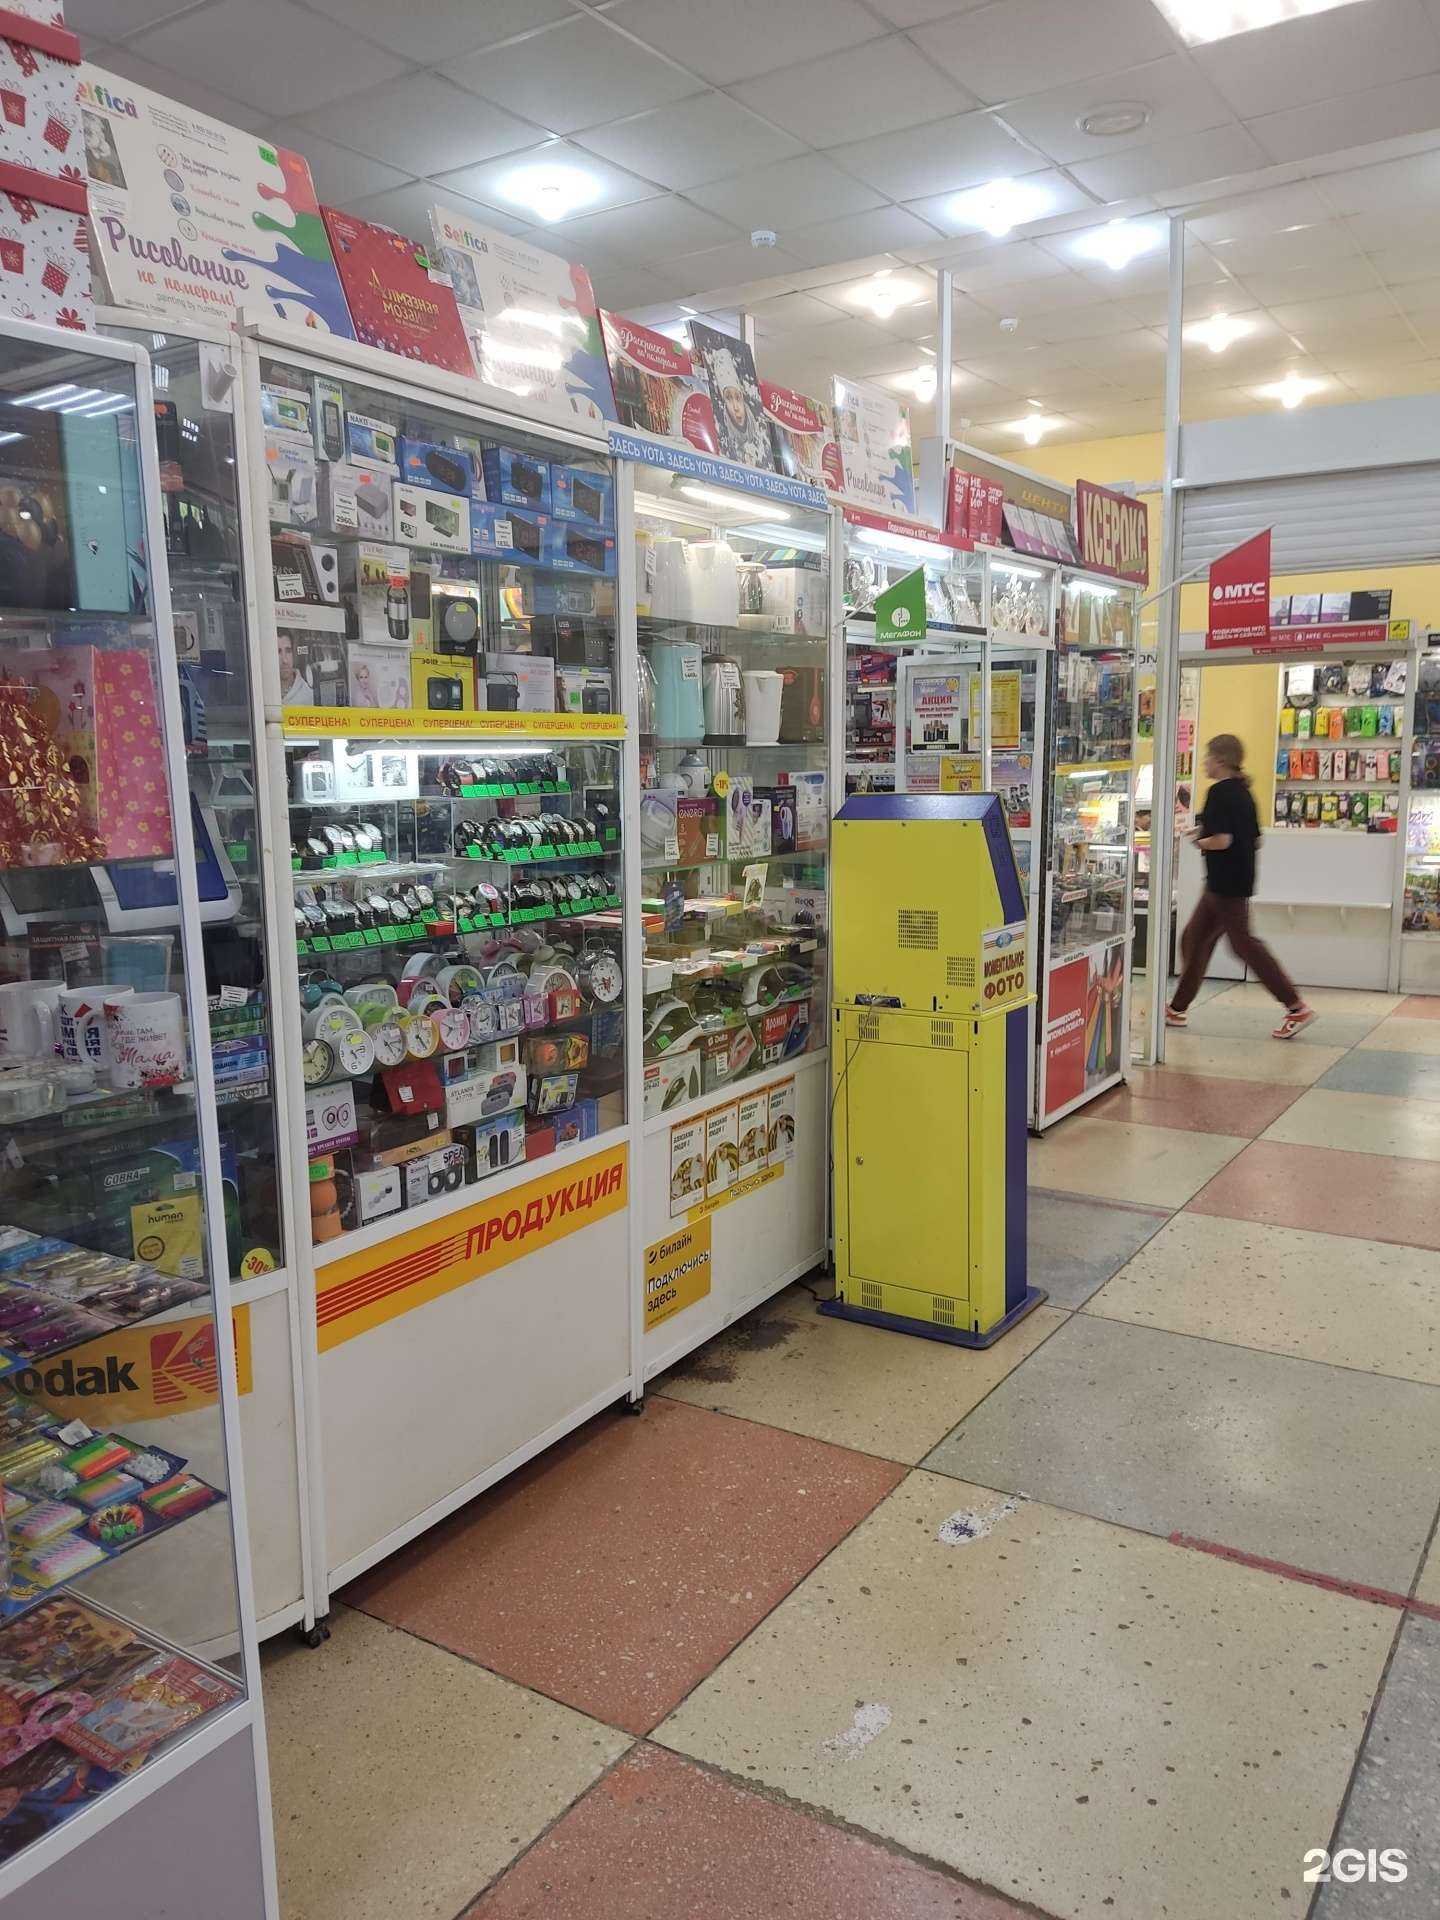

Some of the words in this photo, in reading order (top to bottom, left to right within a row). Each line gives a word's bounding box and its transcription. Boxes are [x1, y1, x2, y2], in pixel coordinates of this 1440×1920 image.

[75, 82, 138, 119] elfica
[100, 216, 249, 290] Рисование
[164, 277, 236, 307] номерам!
[609, 435, 640, 456] ЗДЕСЬ
[641, 446, 665, 464] YOTA
[667, 451, 695, 471] ЗДЕСЬ
[696, 458, 718, 477] YOTA
[719, 464, 745, 484] ЗДЕСЬ
[745, 470, 764, 489] YOTA
[764, 476, 789, 495] ЗДЕСЬ
[788, 482, 807, 500] YOTA
[1083, 490, 1146, 569] КСЕРОКС
[1225, 582, 1266, 599] МТС
[288, 716, 350, 727] СУПЕРЦЕНА!
[360, 717, 414, 728] СУПЕРЦЕНА!
[423, 718, 473, 728] СУПЕРЦЕНА!
[480, 719, 526, 728] СУПЕРЦЕНА!
[533, 720, 575, 729] СУПЕРЦЕНА!
[580, 721, 619, 730] СУПЕРЦЕНА!
[984, 951, 1024, 978] МОМЕНТАЛЬНОЕ
[984, 971, 1025, 999] ФОТО
[147, 1211, 184, 1224] human
[465, 1163, 624, 1260] ПРОДУКЦИЯ
[659, 1233, 692, 1259] билайн
[647, 1287, 677, 1312] здесь
[5, 1356, 139, 1397] odak
